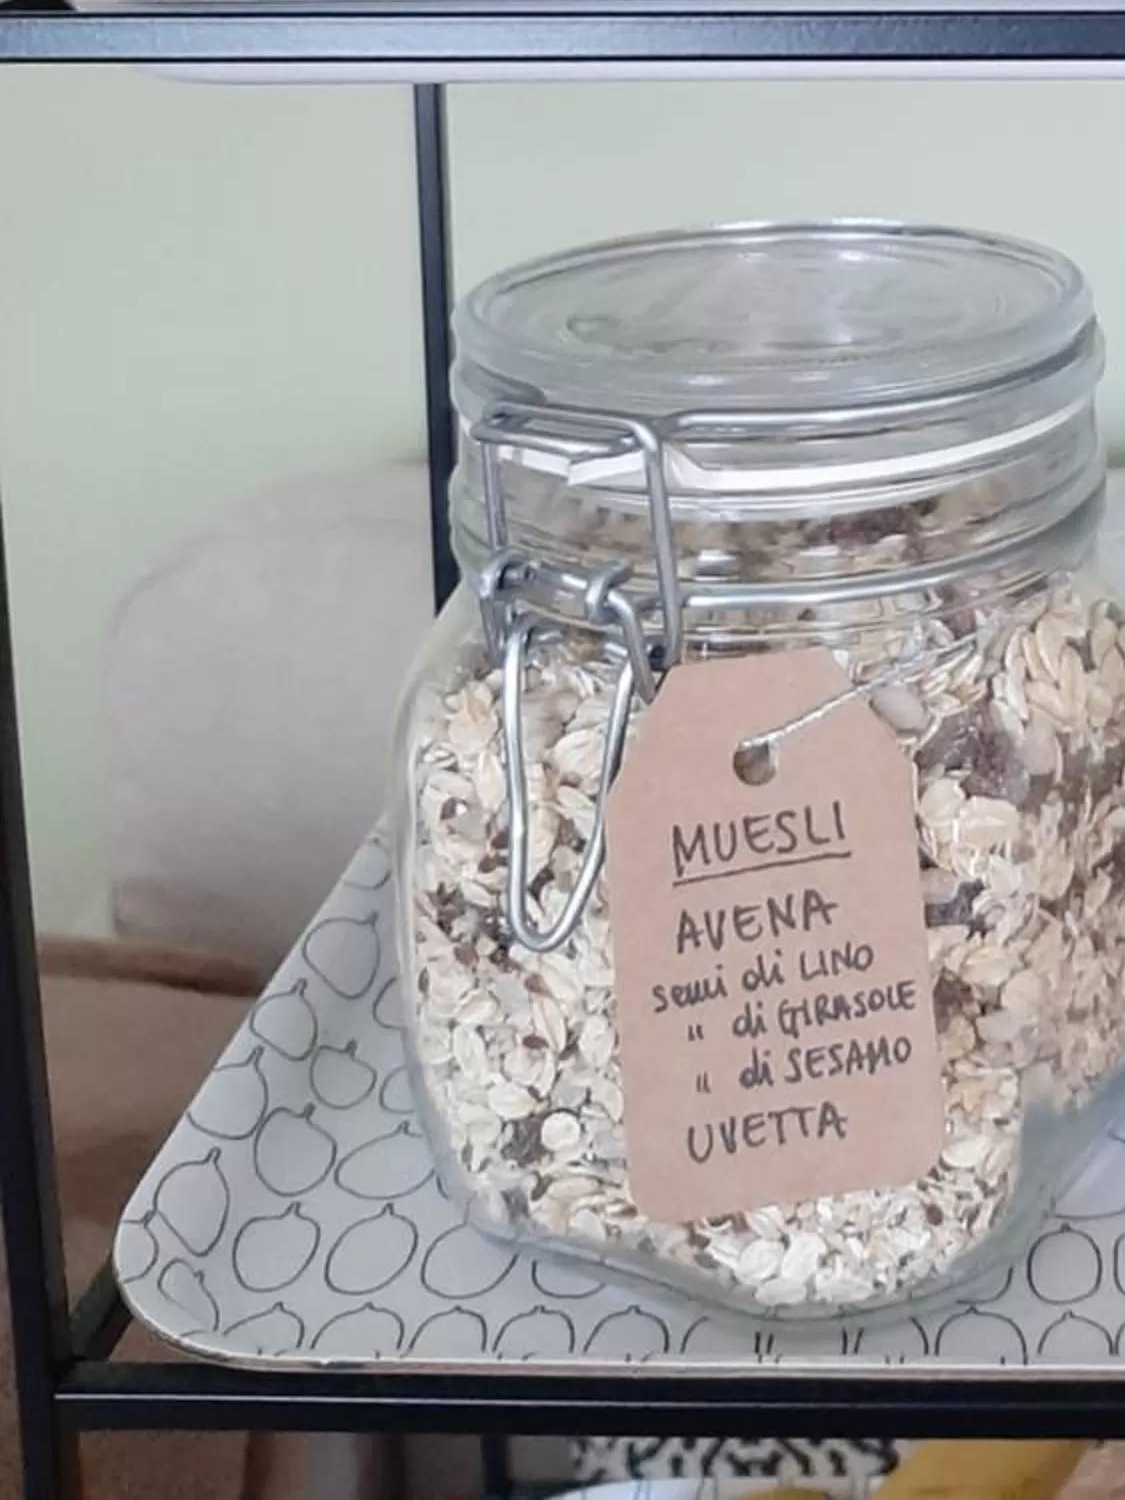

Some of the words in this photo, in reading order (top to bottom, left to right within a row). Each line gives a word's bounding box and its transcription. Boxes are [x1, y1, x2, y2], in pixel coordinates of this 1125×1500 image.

[672, 801, 847, 877] MUESLI
[675, 889, 839, 955] AVENA
[741, 948, 785, 992] di
[799, 941, 874, 982] LINO
[732, 1000, 767, 1039] di
[777, 980, 918, 1038] GIRASOLE
[739, 1048, 774, 1090] di
[784, 1036, 912, 1083] SESAMO
[687, 1100, 848, 1163] UVETTA
